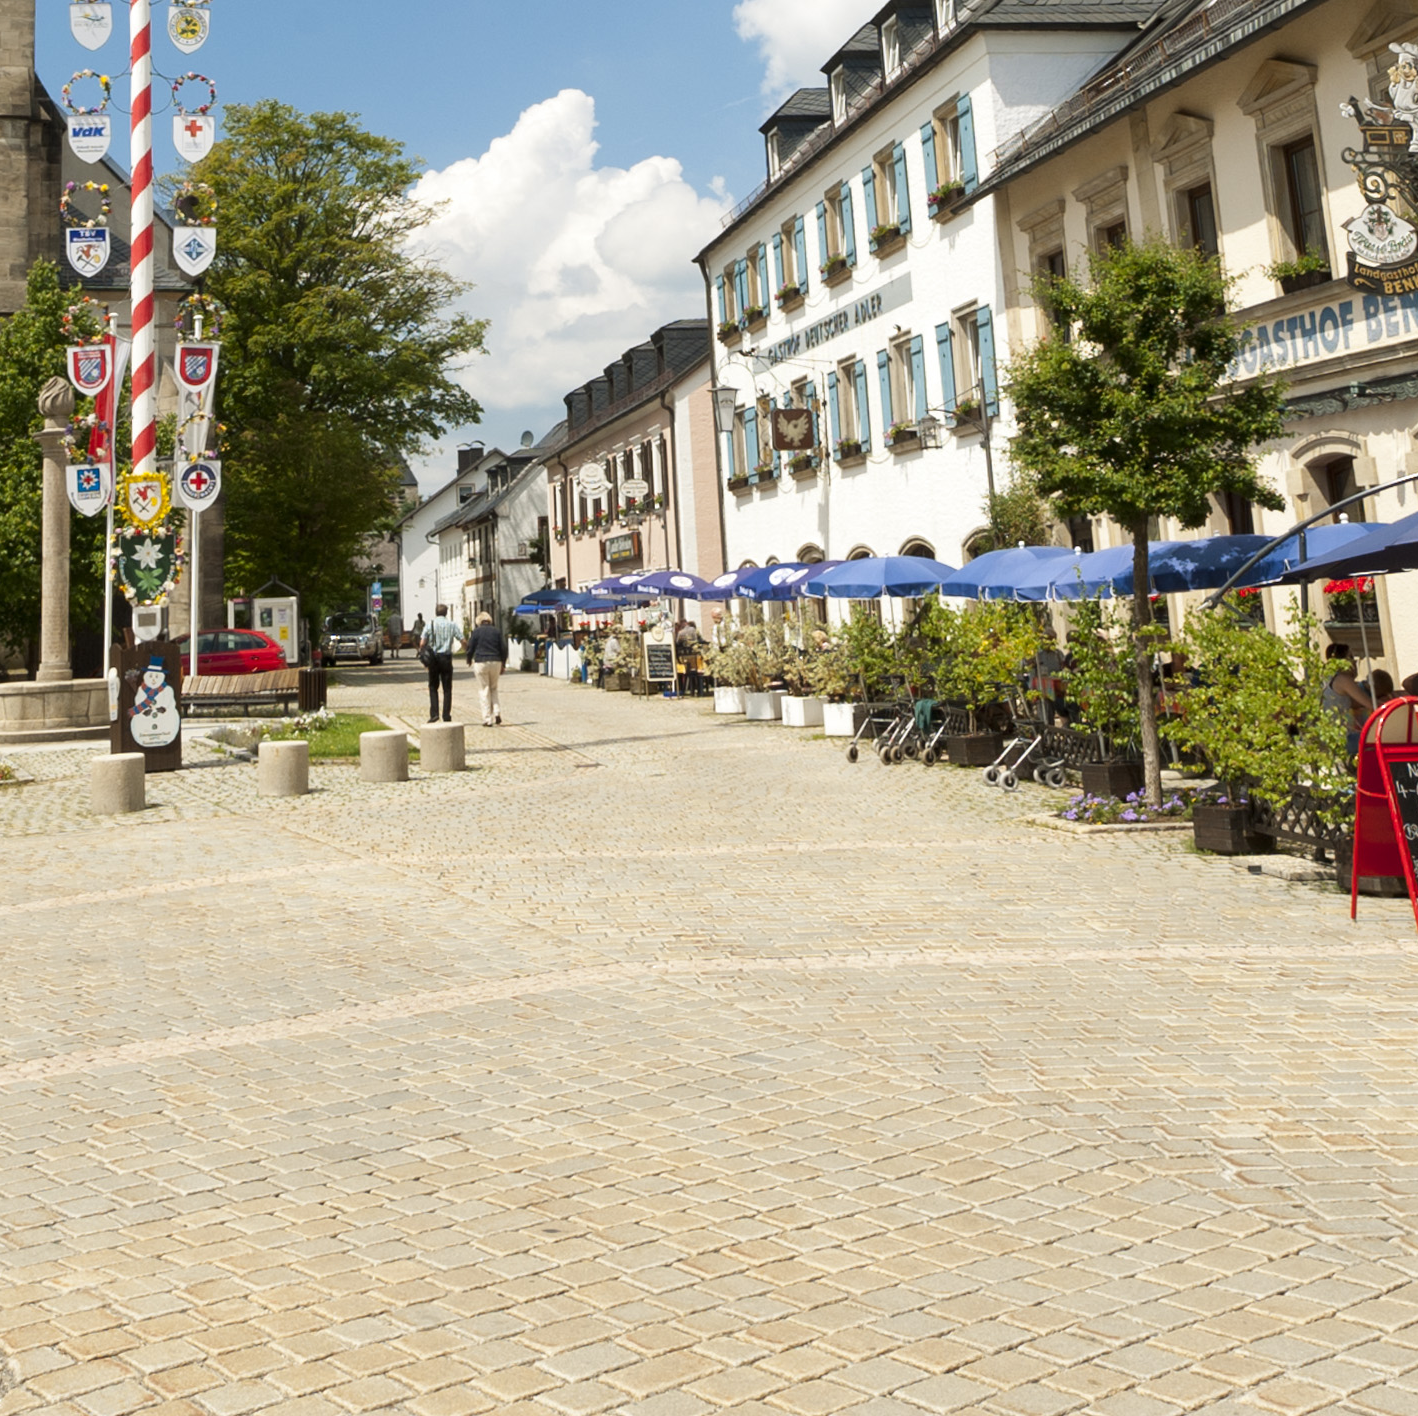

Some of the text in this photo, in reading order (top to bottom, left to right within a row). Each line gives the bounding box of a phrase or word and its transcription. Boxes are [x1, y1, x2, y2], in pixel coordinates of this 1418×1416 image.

[72, 127, 106, 137] VdK
[768, 293, 883, 367] GASTHOF DEUTSCHER ADLER
